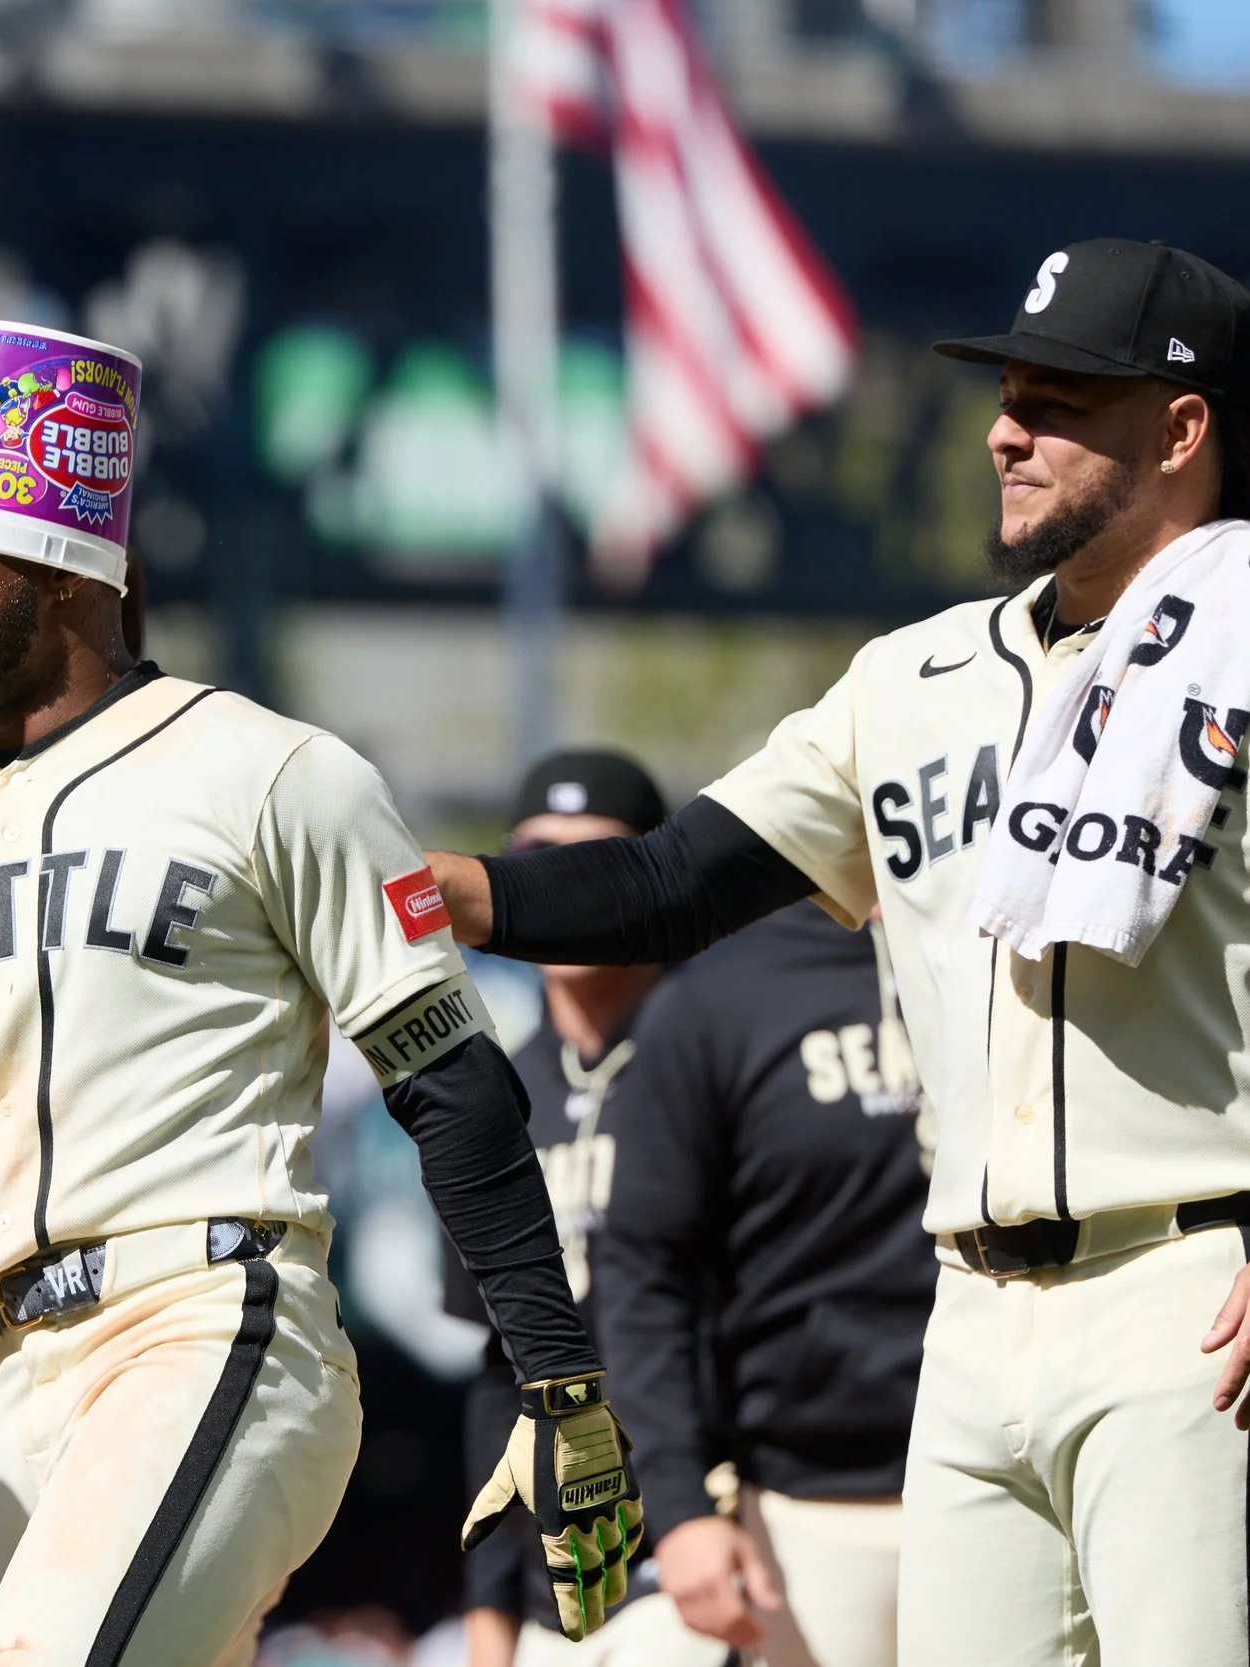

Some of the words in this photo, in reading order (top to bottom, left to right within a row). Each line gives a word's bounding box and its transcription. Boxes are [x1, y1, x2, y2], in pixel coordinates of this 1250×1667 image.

[1024, 251, 1069, 314] S
[70, 360, 127, 396] FLAVORS!
[72, 397, 97, 414] GUM
[97, 405, 122, 419] BUBBLE
[40, 420, 129, 454] BUBBLE
[42, 446, 129, 480] DUBBLE
[71, 494, 109, 510] AMERICA'S
[78, 486, 108, 501] ORIGINAL
[364, 1045, 398, 1077] IN
[387, 989, 474, 1063] FRONT
[565, 1470, 623, 1505] franklin
